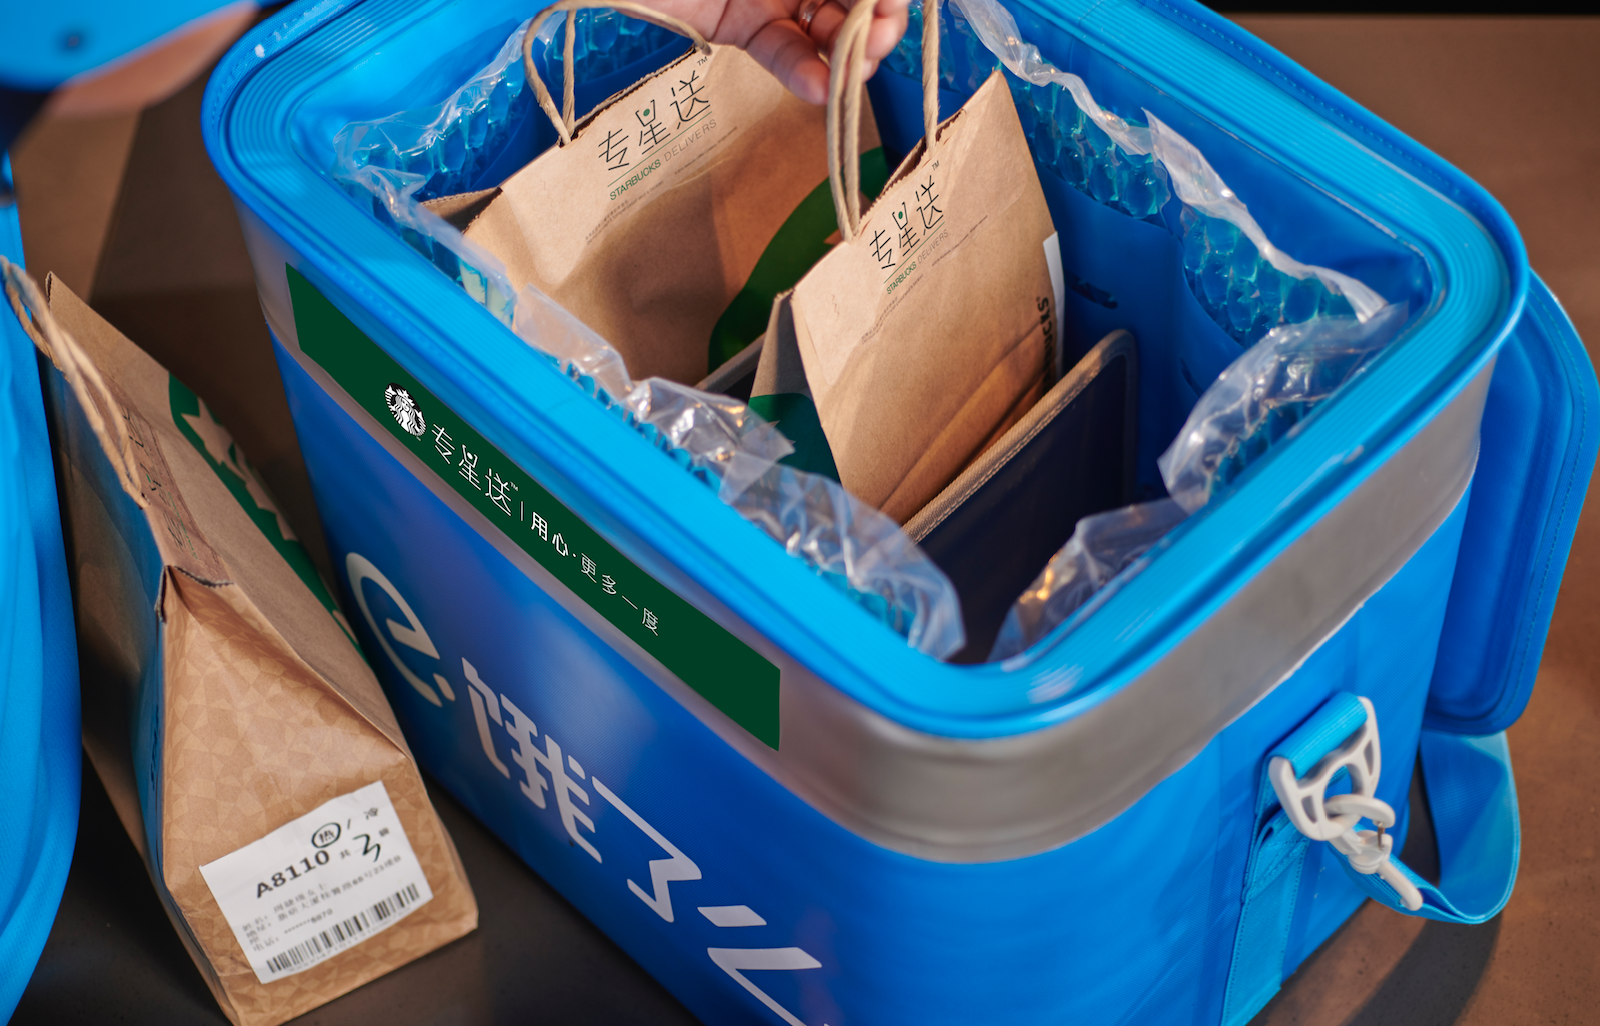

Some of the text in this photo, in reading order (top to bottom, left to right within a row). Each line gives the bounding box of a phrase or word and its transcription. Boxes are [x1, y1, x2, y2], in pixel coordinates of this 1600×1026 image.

[598, 70, 711, 171] 专星送
[609, 158, 662, 201] STARBUCKS
[663, 119, 717, 162] DELIVERS
[869, 175, 944, 269] 专星送
[886, 228, 949, 295] STARBUCKS DELIVERS
[431, 423, 512, 517] 专星送
[256, 850, 330, 898] A8110
